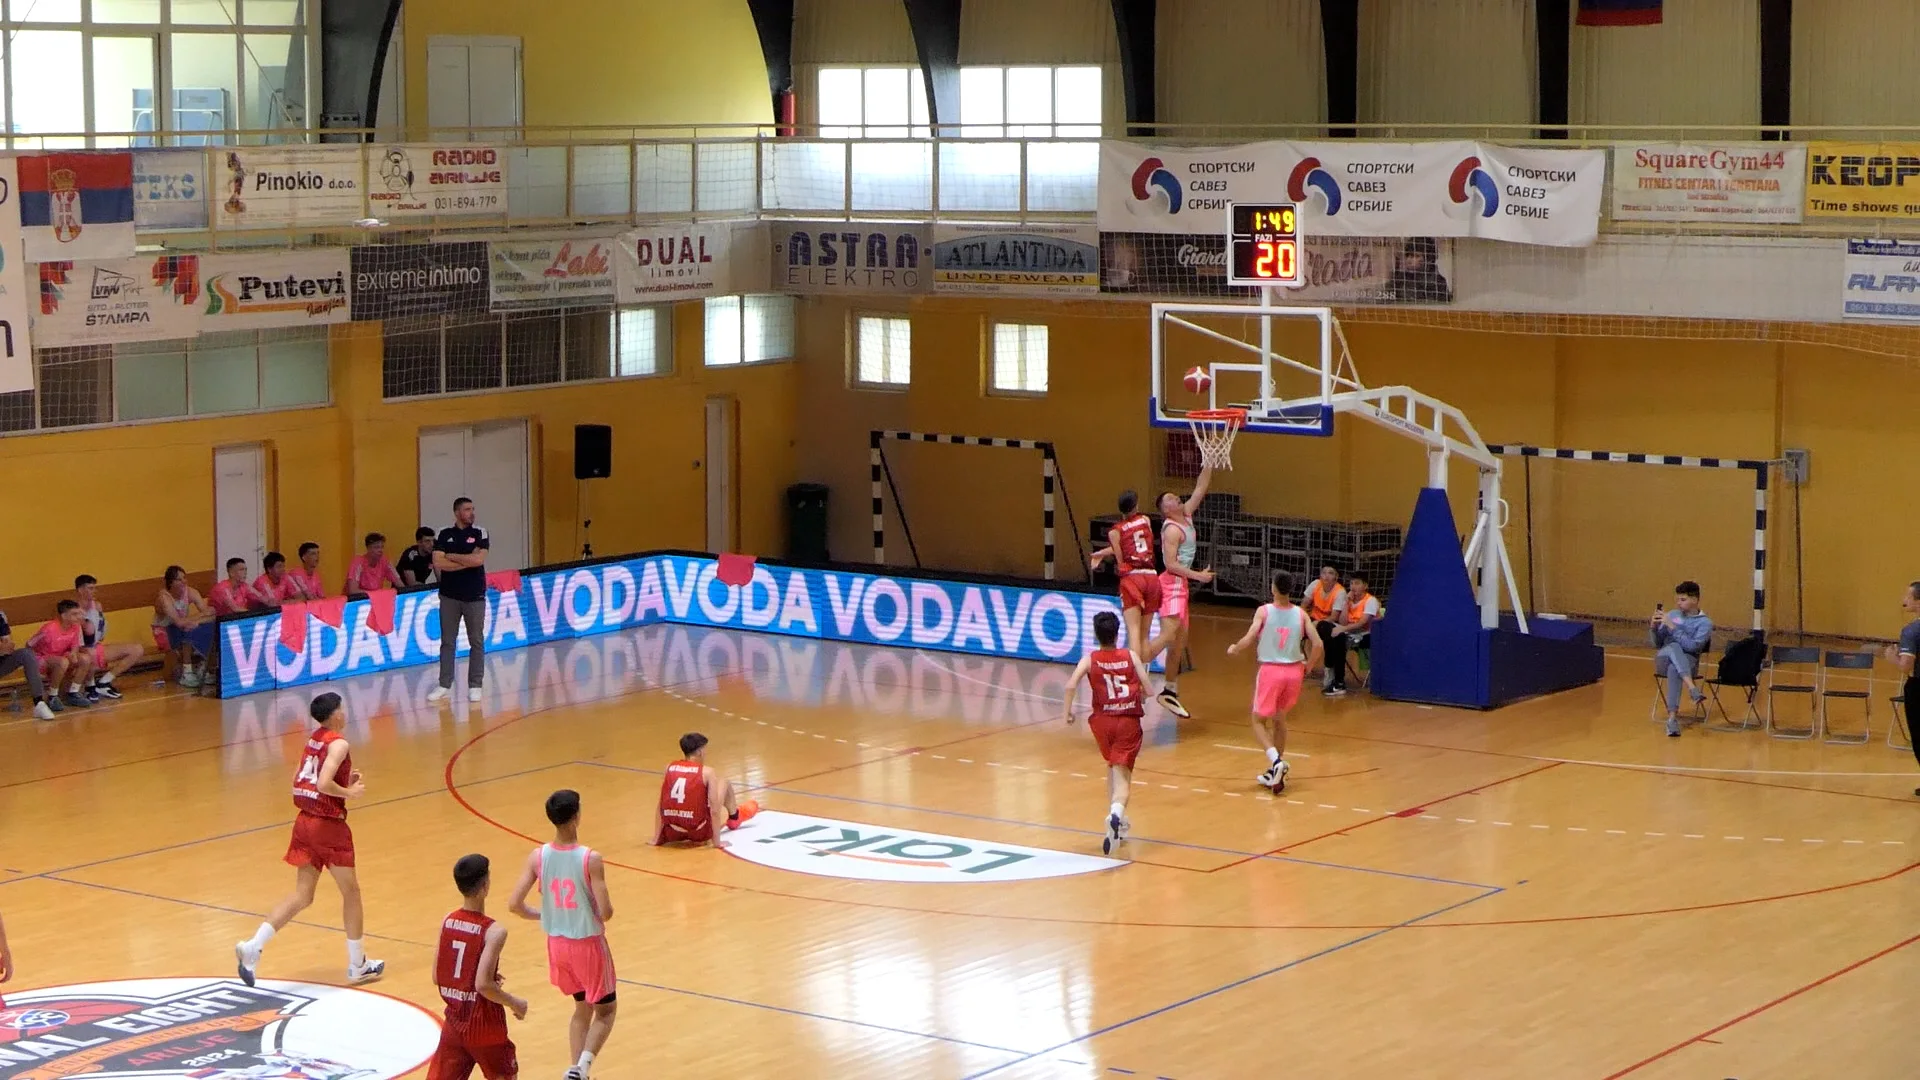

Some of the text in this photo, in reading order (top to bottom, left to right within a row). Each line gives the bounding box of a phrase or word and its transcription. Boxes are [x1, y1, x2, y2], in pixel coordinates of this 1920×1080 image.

[1188, 162, 1256, 173] СПОРТСКИ
[1346, 163, 1414, 174] СПОРТСКИ
[1635, 148, 1785, 174] SquareGym44
[255, 171, 356, 191] Pinokio d.o.o.
[1507, 165, 1576, 182] СПОРТСКИ
[1190, 181, 1227, 191] САВЕЗ
[1347, 182, 1386, 192] САВЕЗ
[1506, 184, 1546, 199] САВЕЗ
[1675, 178, 1716, 191] CENTAR
[1347, 200, 1393, 212] СРБИЈЕ
[1505, 203, 1550, 219] СРБИЈЕ
[1811, 199, 1848, 212] Time
[1852, 203, 1898, 213] shows
[1255, 210, 1295, 232] 1:49
[1254, 234, 1273, 242] FAZI
[543, 240, 611, 278] Laki
[637, 236, 713, 266] DUAL
[788, 231, 918, 268] ASTRA
[945, 240, 1087, 269] ATLANTIDA
[1256, 243, 1295, 278] 20
[651, 265, 700, 278] limovi
[788, 267, 918, 287] ELEKTRO
[945, 271, 1086, 283] UNDERWEAR
[238, 270, 346, 301] Putevi
[1375, 290, 1397, 300] 288
[1133, 529, 1148, 553] 5
[1103, 674, 1130, 700] 15
[670, 777, 687, 804] 4
[549, 878, 578, 910] 12
[452, 940, 467, 978] 7
[127, 1034, 239, 1066] ARILJE
[181, 1048, 247, 1067] 2024
